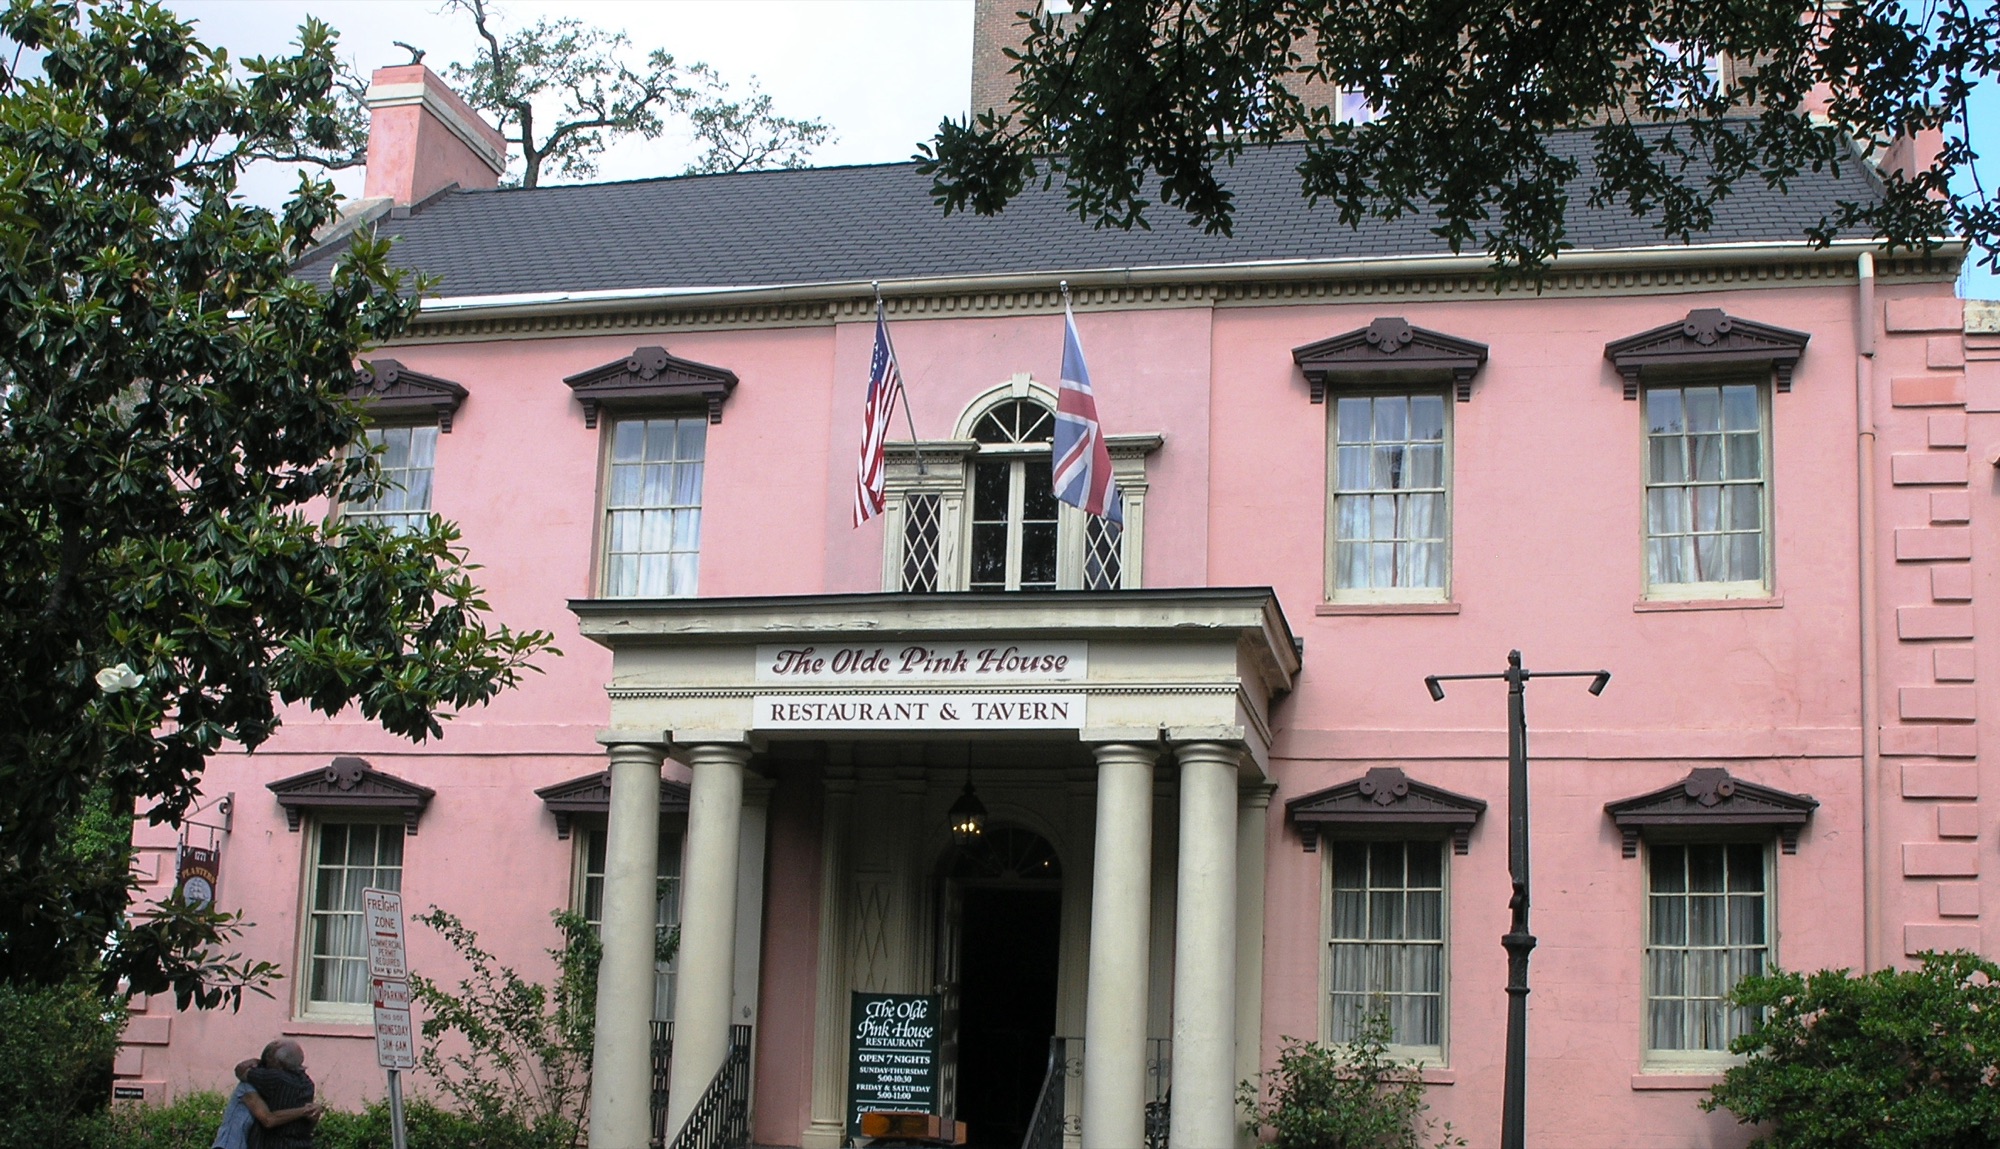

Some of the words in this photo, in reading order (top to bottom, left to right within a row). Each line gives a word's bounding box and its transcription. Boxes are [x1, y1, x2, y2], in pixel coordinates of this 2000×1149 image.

[772, 647, 827, 675] The
[831, 648, 890, 674] Olde
[898, 646, 969, 674] Pink
[976, 646, 1070, 674] House
[771, 702, 929, 722] RESTAURANT
[939, 702, 960, 721] &
[971, 701, 1070, 721] TAVERN
[367, 898, 399, 912] FREIGHT
[375, 916, 396, 929] ZONE
[383, 989, 407, 1003] PARKING
[865, 998, 895, 1018] The
[897, 1000, 928, 1020] Olde
[378, 1023, 408, 1036] WEDNESDAY
[856, 1016, 893, 1039] Pink
[891, 1018, 934, 1039] House
[865, 1037, 925, 1048] RESTAURANT
[858, 1053, 885, 1063] OPEN
[886, 1054, 893, 1065] 7
[894, 1055, 931, 1065] NIGHTS
[856, 1083, 883, 1092] FRIDAY
[892, 1085, 931, 1094] SATURDAY
[876, 1091, 912, 1101] 5:00-11:00
